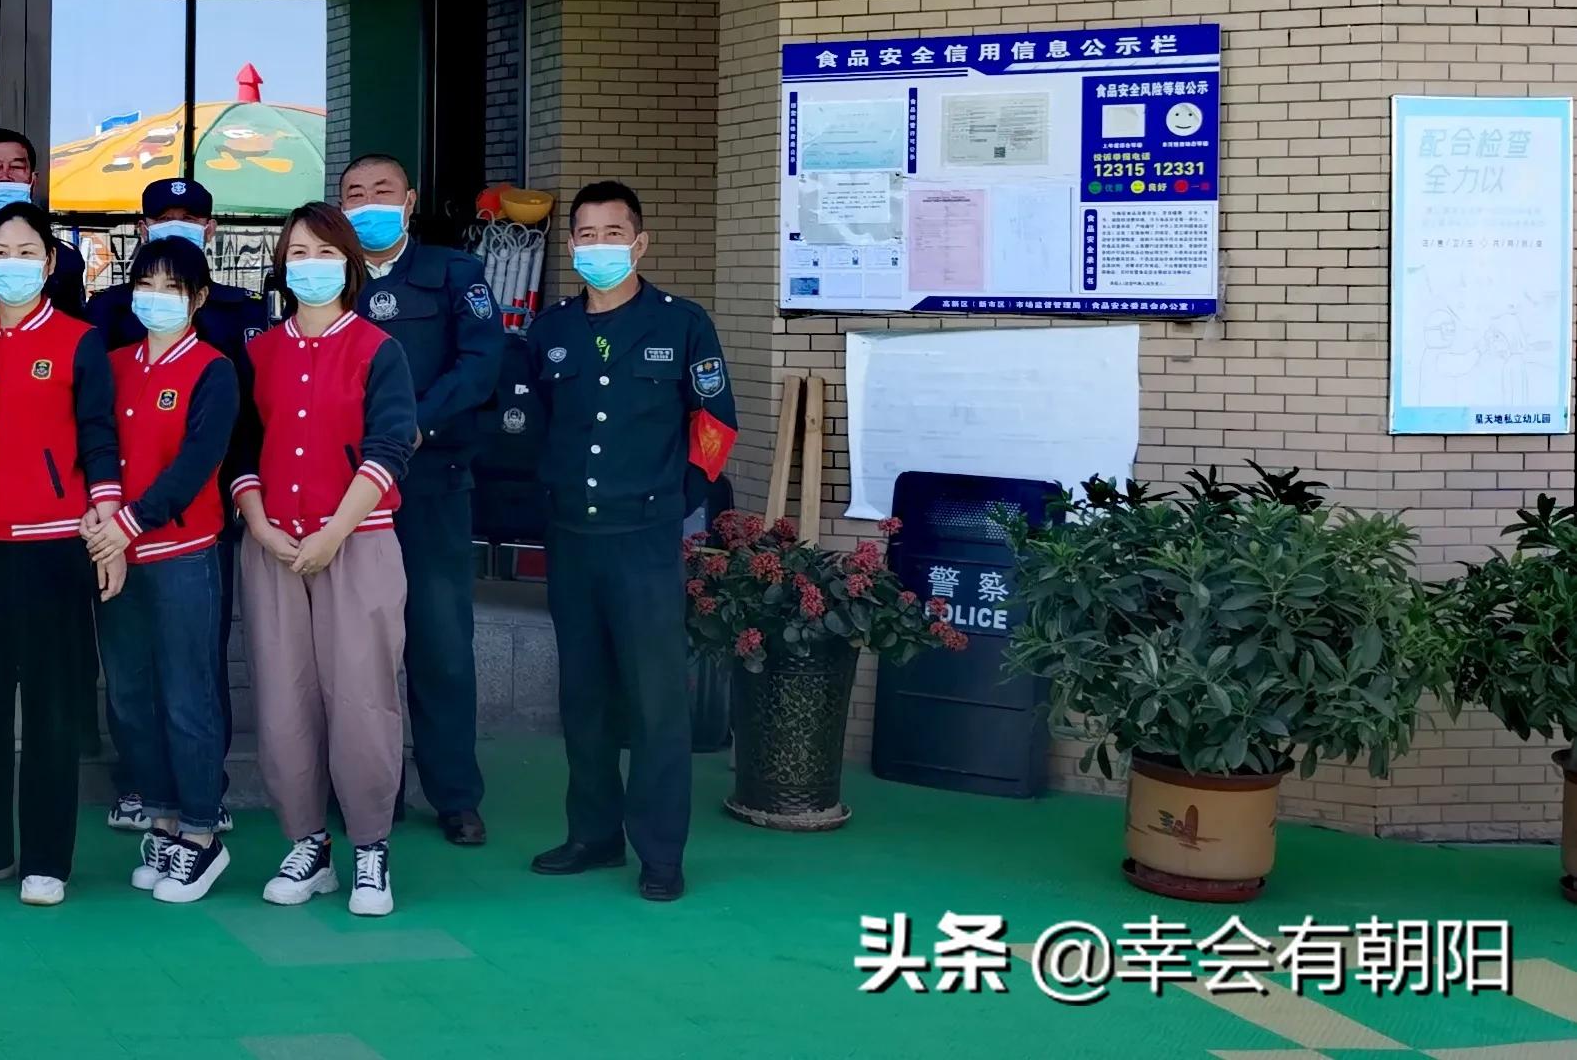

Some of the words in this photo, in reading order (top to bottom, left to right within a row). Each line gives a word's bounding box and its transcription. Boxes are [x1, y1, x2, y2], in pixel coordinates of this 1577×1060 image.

[816, 34, 1179, 69] 食品安全信用信息公示栏
[1096, 80, 1209, 98] 食品安全风险等级公示
[1419, 128, 1533, 159] 配合检查
[1094, 163, 1145, 177] 12315
[1153, 162, 1204, 176] 12331
[1422, 164, 1506, 195] 全力以
[1474, 413, 1552, 425] 星天地私立幼儿园
[927, 565, 1010, 603] 警察
